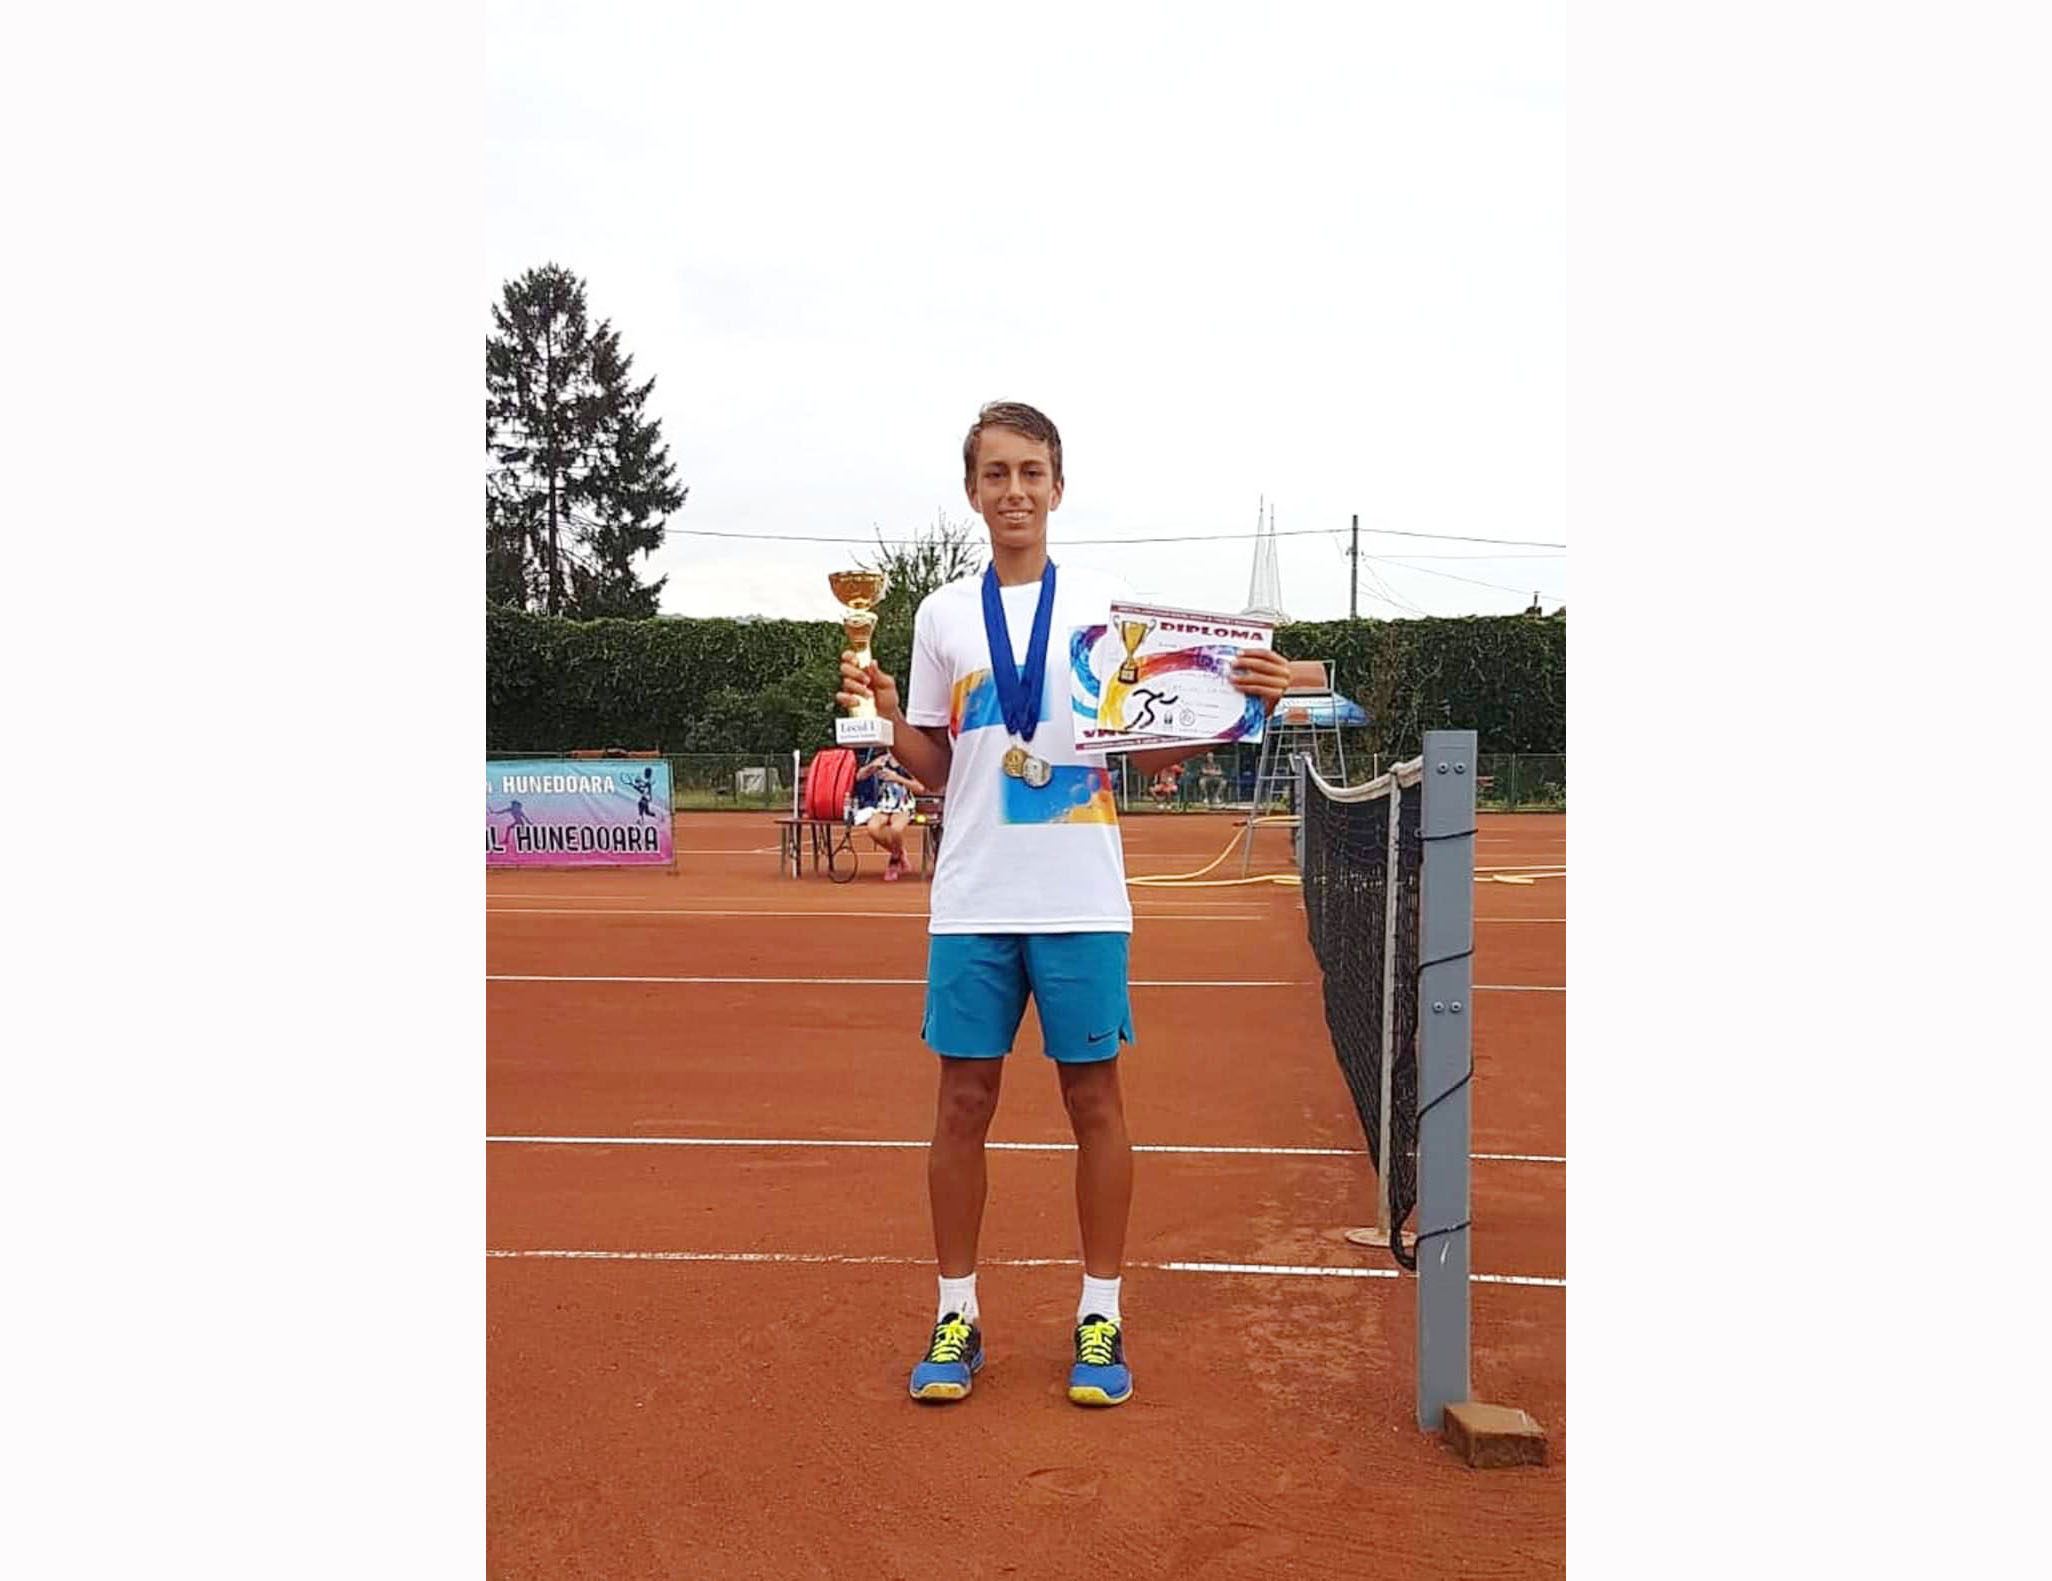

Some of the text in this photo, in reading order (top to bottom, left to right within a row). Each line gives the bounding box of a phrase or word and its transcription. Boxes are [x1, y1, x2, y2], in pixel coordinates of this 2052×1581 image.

[1160, 621, 1264, 641] DIPLOMA
[503, 775, 614, 793] HUNEDOARA
[516, 825, 658, 851] HUNEDOARA
